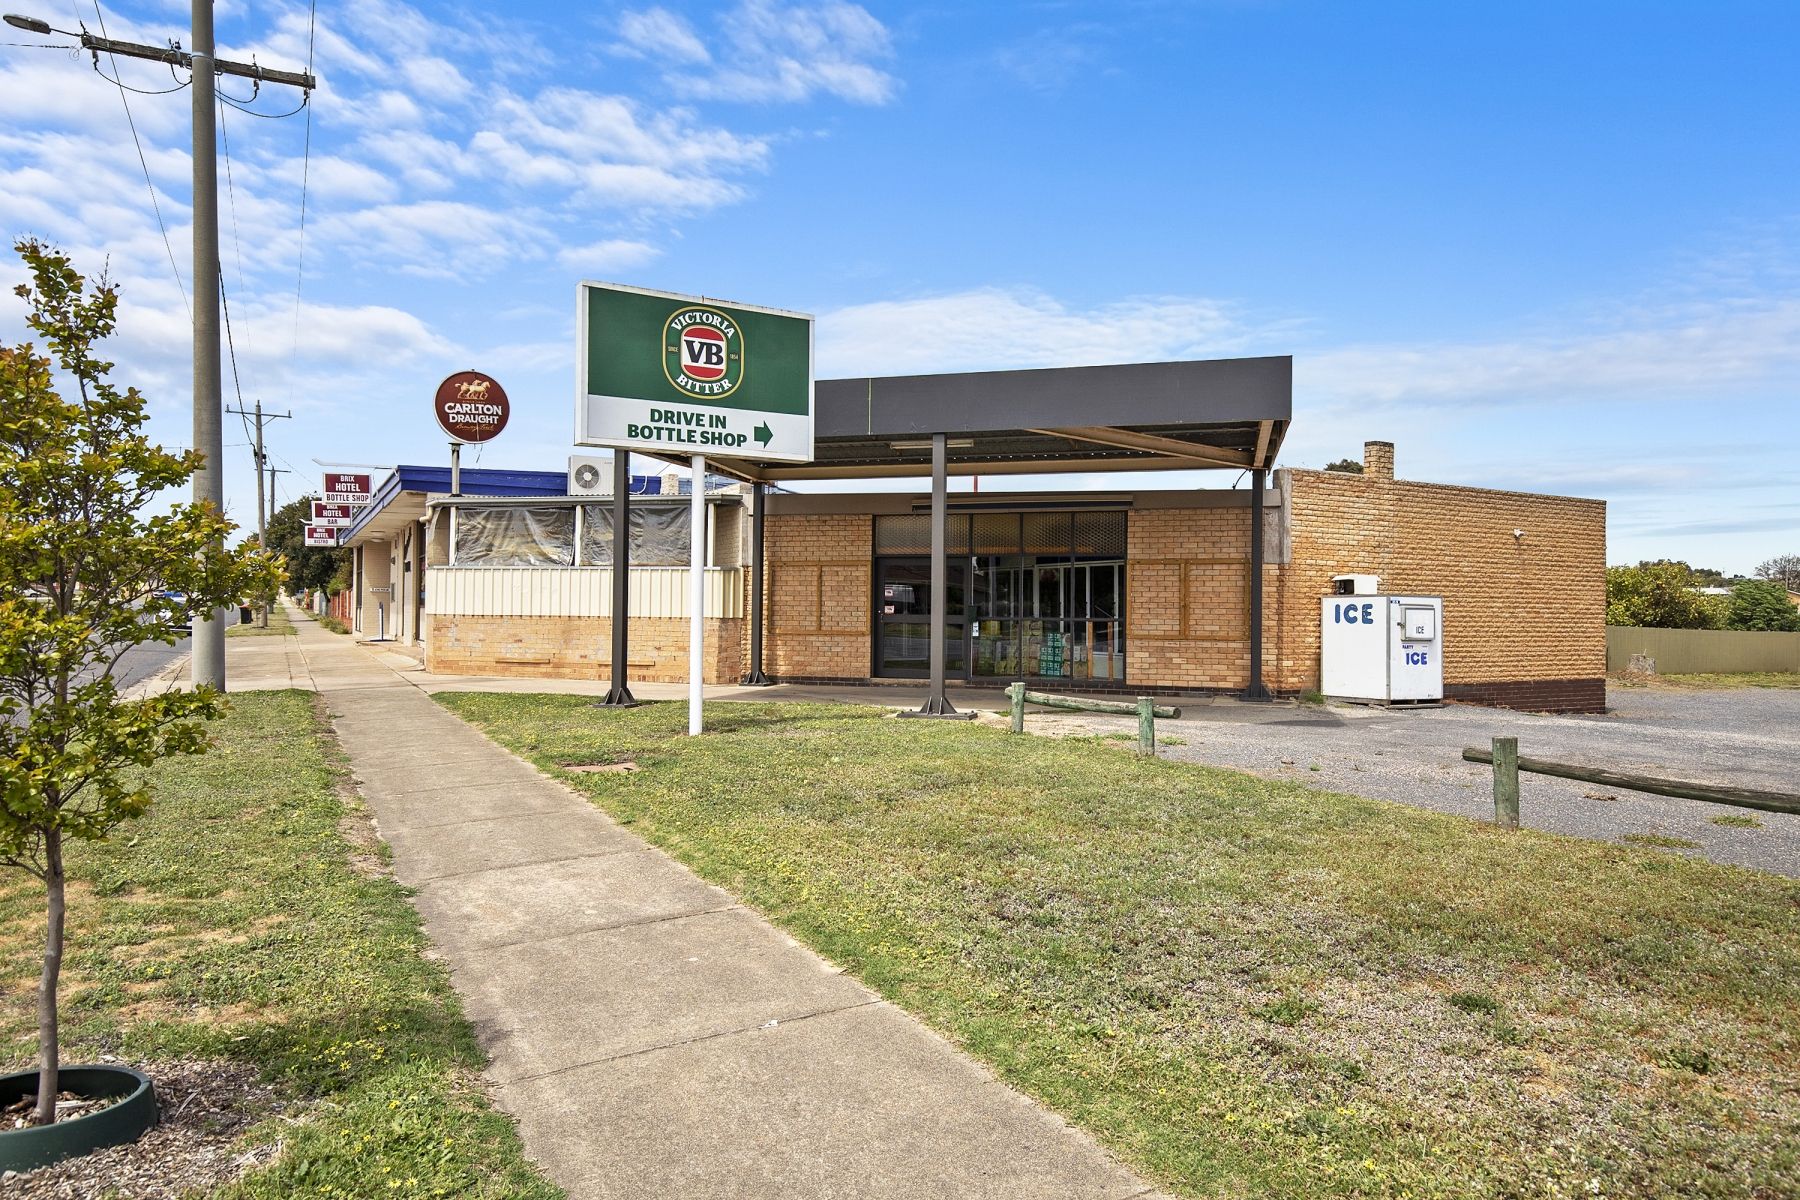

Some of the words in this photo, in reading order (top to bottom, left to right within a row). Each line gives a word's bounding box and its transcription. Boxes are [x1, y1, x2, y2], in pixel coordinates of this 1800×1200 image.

[671, 311, 735, 340] VICTORIA
[684, 340, 724, 366] VB
[676, 373, 732, 394] BITTER
[444, 402, 502, 416] CARLTON
[449, 414, 499, 424] DRAUGHT
[650, 408, 705, 428] DRIVE
[708, 414, 727, 430] IN
[628, 424, 697, 444] BOTTLE
[700, 431, 748, 448] SHOP
[336, 483, 360, 492] HOTEL
[326, 494, 350, 502] BOTTLE
[1334, 604, 1374, 624] ICE
[1416, 626, 1424, 634] ICE
[1406, 652, 1428, 665] ICE
